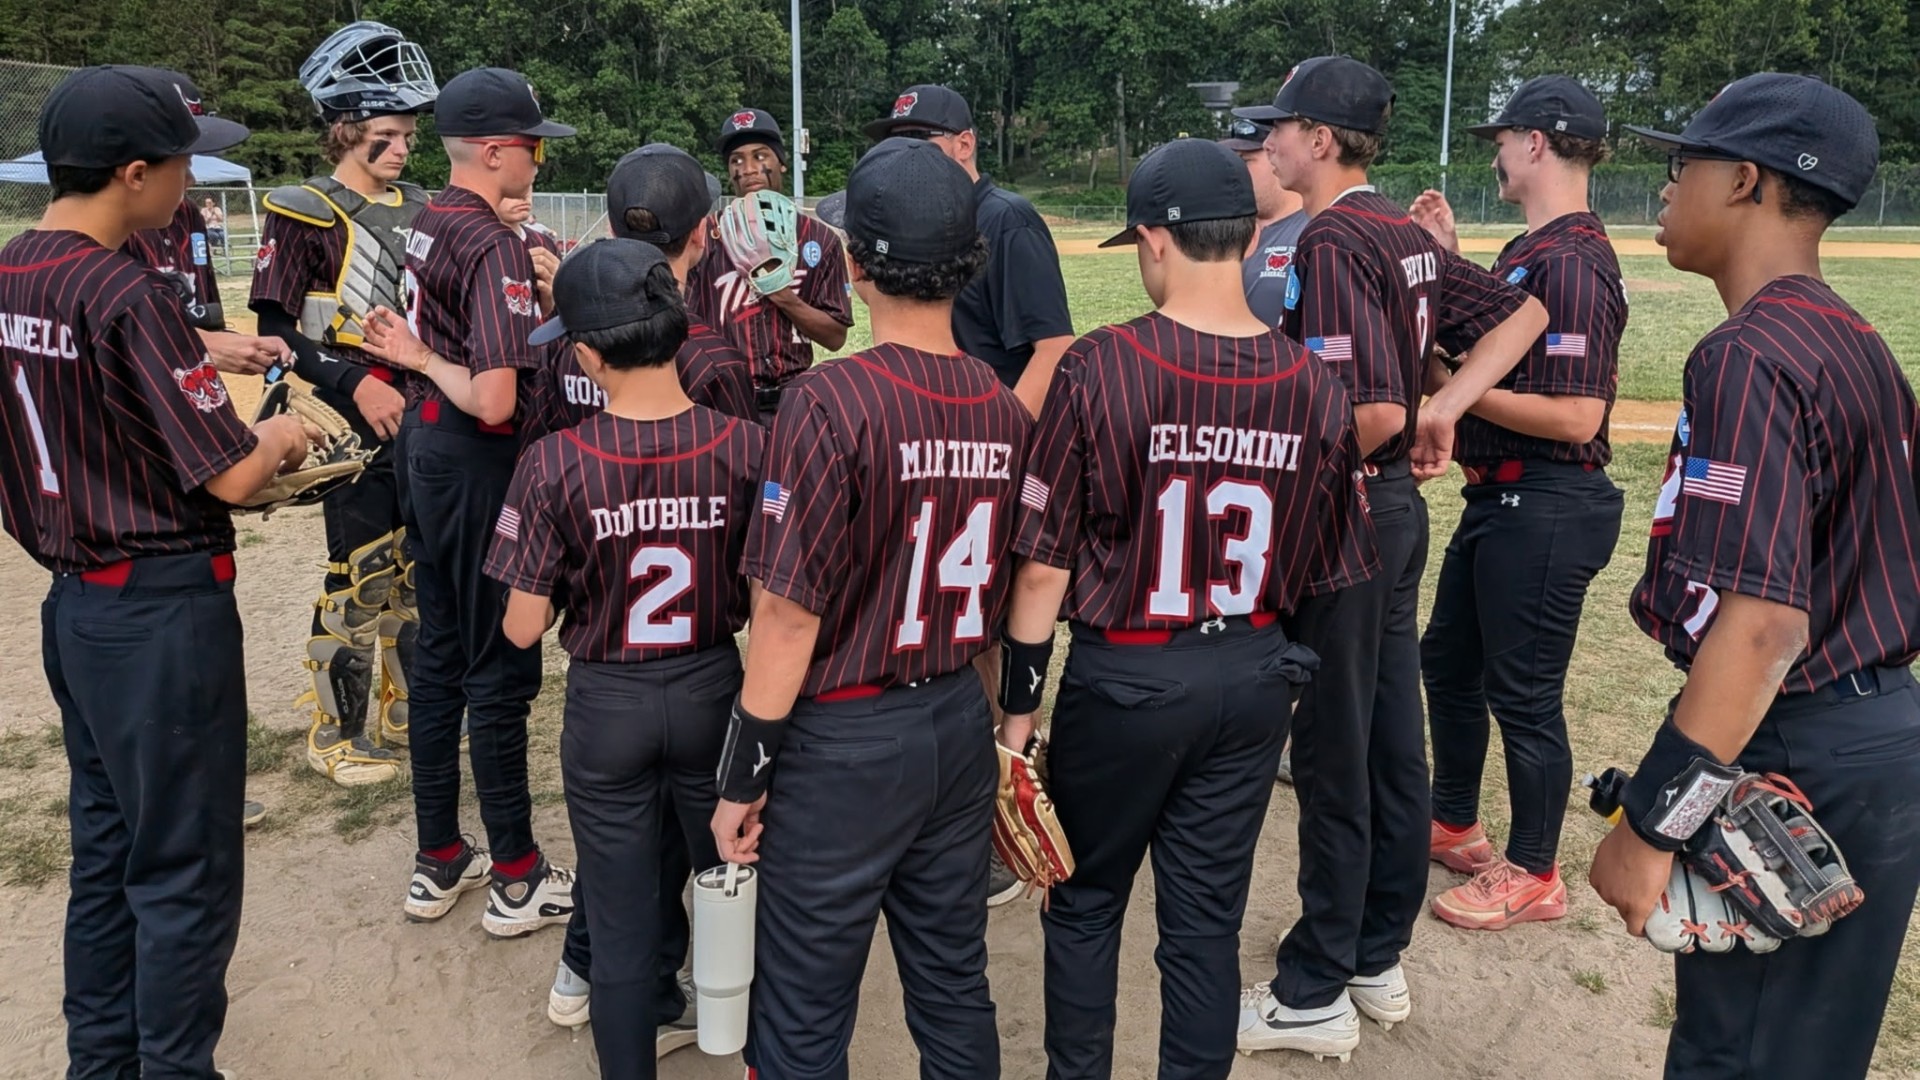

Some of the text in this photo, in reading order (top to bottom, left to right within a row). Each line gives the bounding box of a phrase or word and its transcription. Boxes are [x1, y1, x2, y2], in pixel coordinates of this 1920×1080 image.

[14, 361, 60, 497] 1
[899, 439, 1012, 481] MARTINEZ
[1149, 424, 1302, 471] GELSOMINI
[625, 544, 695, 645] 2
[895, 498, 996, 652] 14
[1147, 476, 1273, 618] 13
